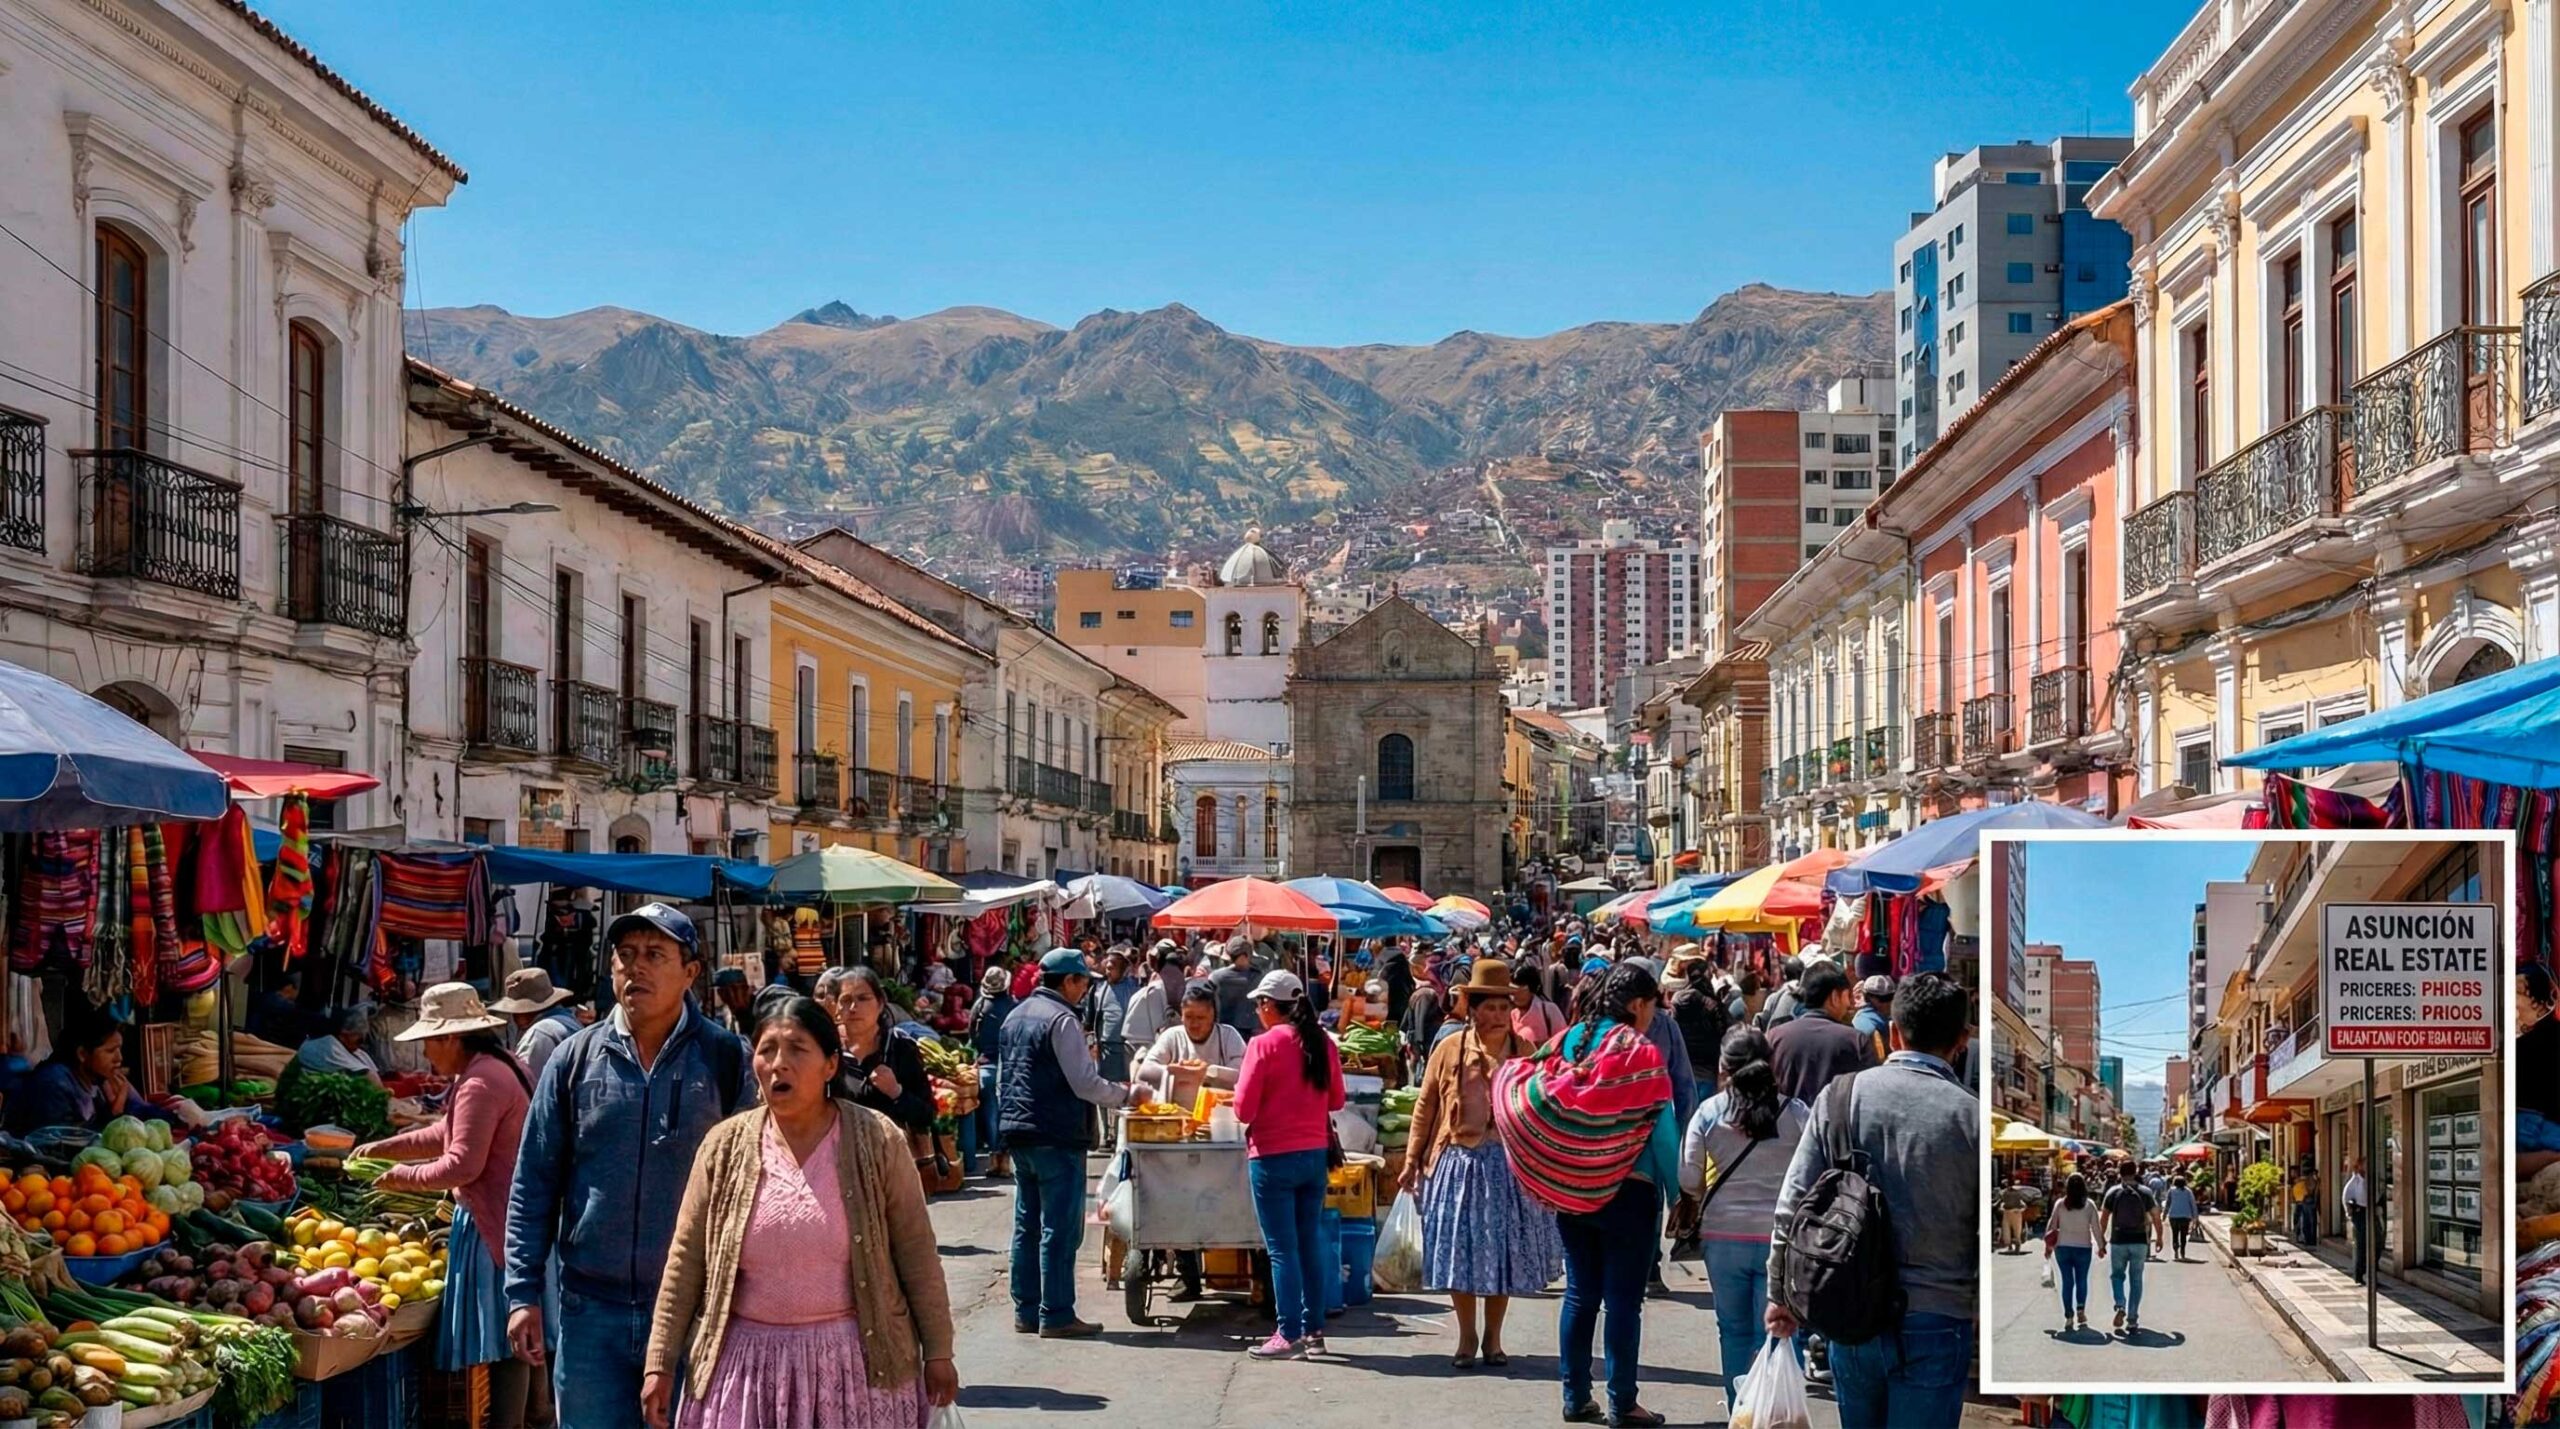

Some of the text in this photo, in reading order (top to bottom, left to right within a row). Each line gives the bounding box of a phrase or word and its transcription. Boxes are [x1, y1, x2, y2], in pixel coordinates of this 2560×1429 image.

[2346, 909, 2474, 939] ASUNCIÓN
[2335, 948, 2487, 971] REAL ESTATE
[2340, 982, 2416, 997] PRICERES:
[2340, 1006, 2416, 1020] PRICERES:
